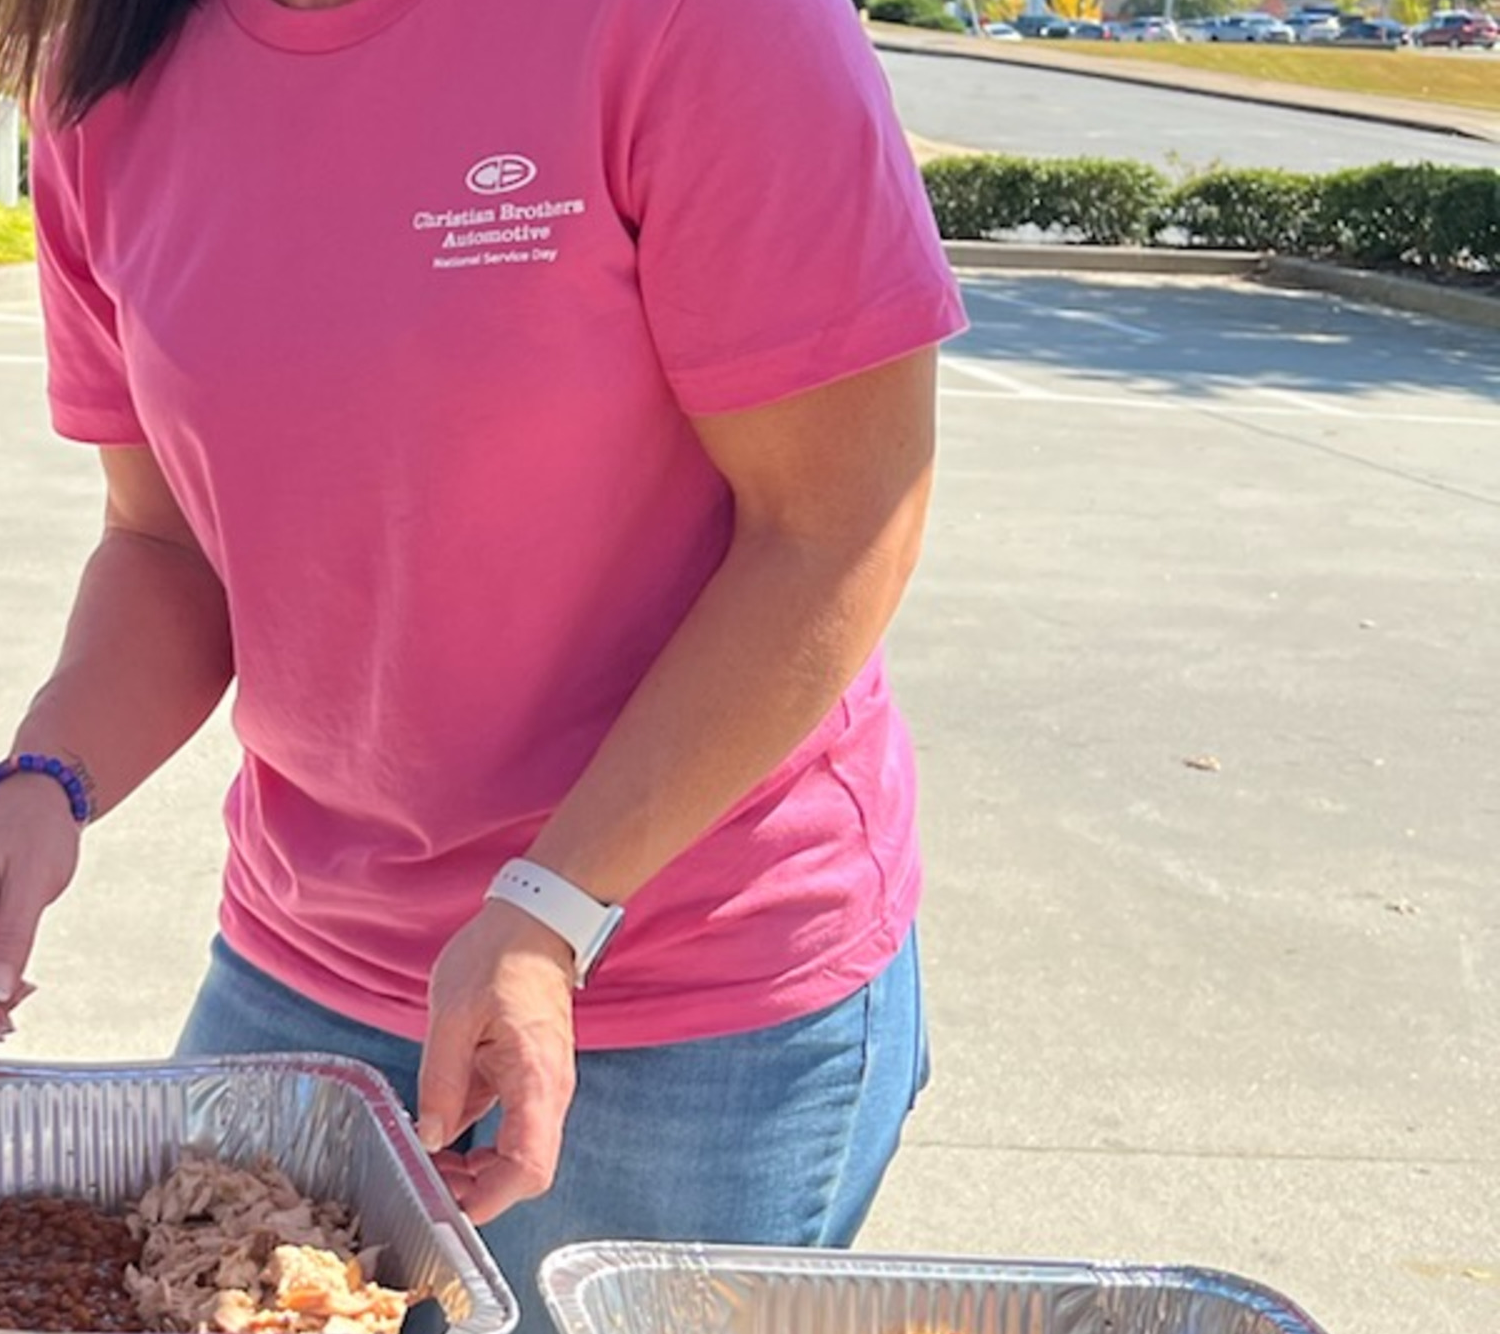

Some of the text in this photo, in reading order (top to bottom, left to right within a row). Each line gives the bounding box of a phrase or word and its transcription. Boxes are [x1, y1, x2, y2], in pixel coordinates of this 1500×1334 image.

[413, 198, 585, 230] Christian Brothers
[442, 224, 551, 249] Automotive
[433, 247, 558, 268] National Service Day
